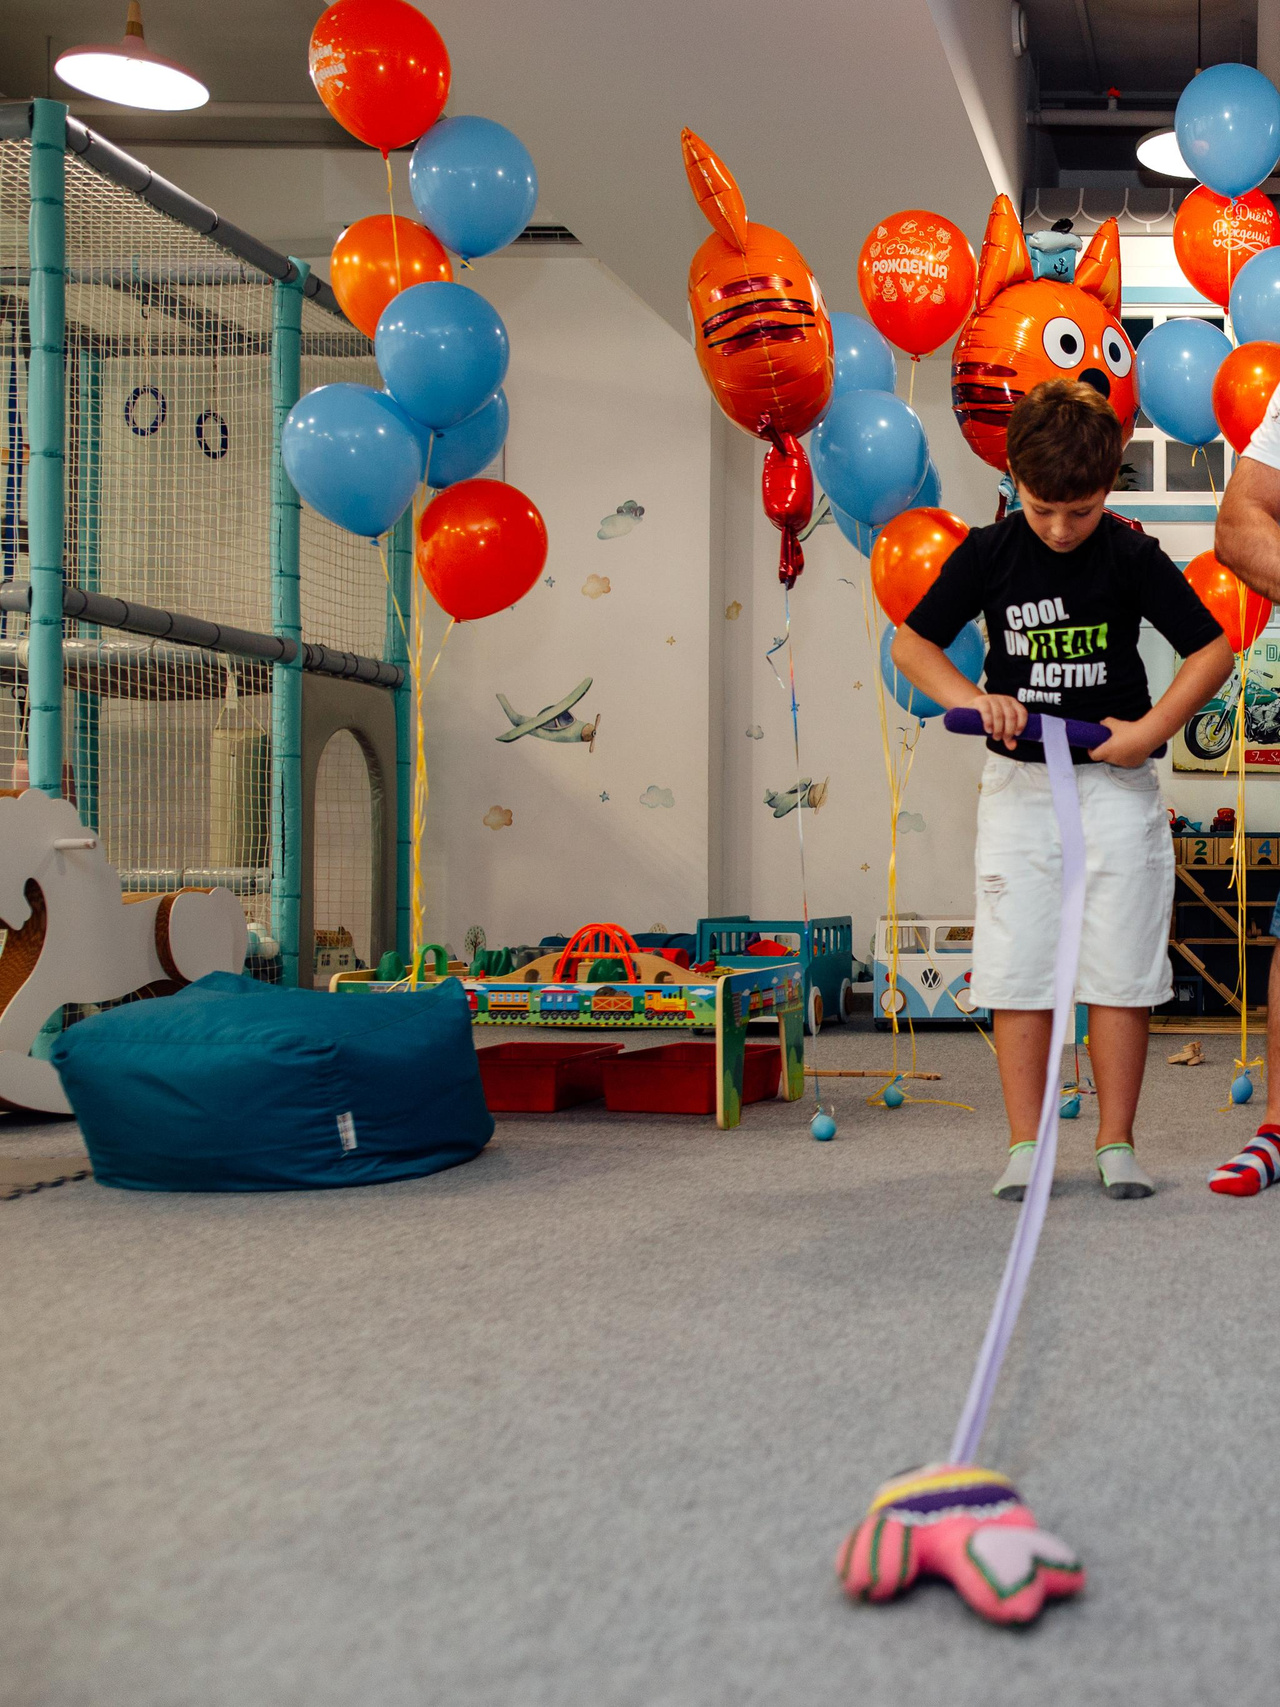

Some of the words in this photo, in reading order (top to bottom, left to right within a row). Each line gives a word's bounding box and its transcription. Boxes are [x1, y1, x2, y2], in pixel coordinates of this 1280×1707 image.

[872, 257, 948, 280] РОЖДЕНИЯ
[1005, 596, 1070, 631] COOL
[1029, 661, 1108, 689] ACTIVE
[1017, 687, 1062, 706] BRAVE
[1250, 751, 1265, 762] For
[1194, 840, 1207, 856] 2
[1258, 840, 1272, 856] 4
